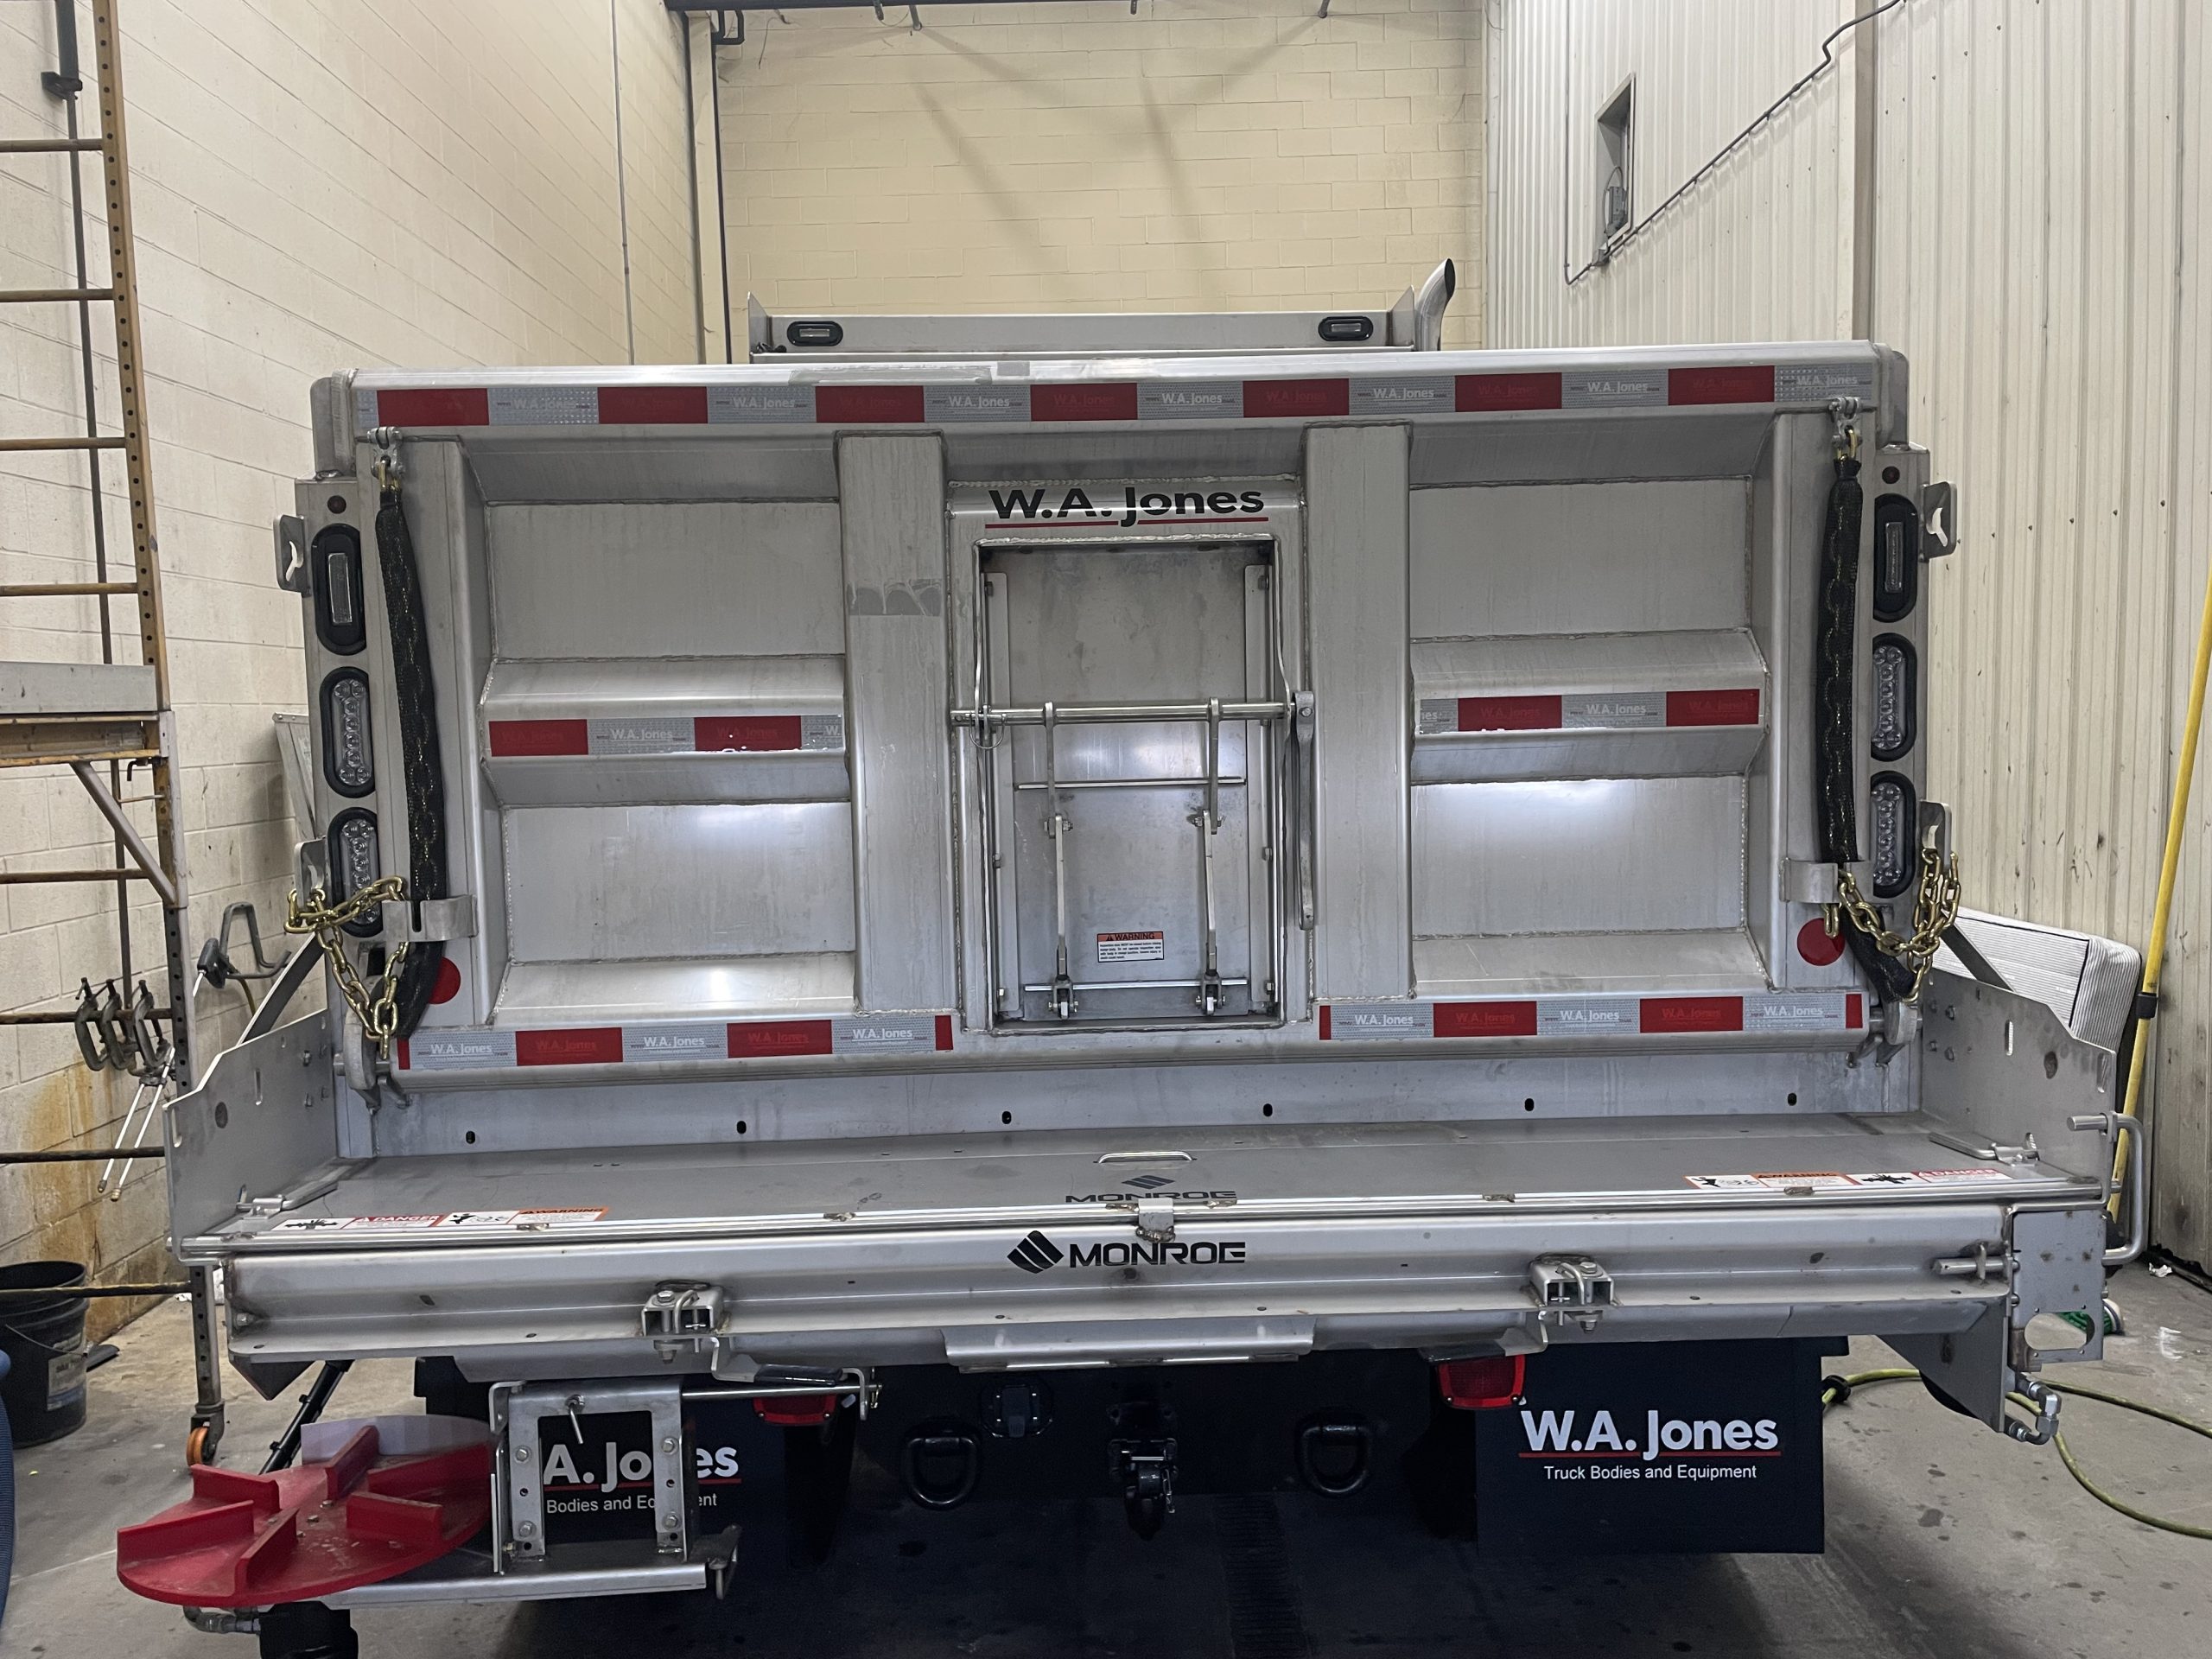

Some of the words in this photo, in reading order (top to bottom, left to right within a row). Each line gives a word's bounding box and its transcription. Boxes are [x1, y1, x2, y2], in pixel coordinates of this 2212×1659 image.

[1587, 382, 1616, 392] W.A.
[1617, 381, 1647, 393] Jones
[1796, 375, 1825, 385] W.A.
[1827, 374, 1858, 387] Jones
[1161, 393, 1190, 404] W.A.
[1192, 392, 1222, 404] Jones
[1373, 388, 1402, 398] W.A.
[1403, 387, 1433, 400] Jones
[732, 397, 762, 408] W.A.
[764, 396, 795, 409] Jones
[948, 395, 977, 406] W.A.
[978, 394, 1009, 408] Jones
[988, 487, 1112, 519] W.A.
[1121, 486, 1264, 527] Jones
[1586, 704, 1613, 715] W.A.
[1616, 703, 1646, 716] Jones
[611, 728, 639, 740] W.A.
[640, 728, 672, 741] Jones
[1115, 932, 1155, 941] WARNING
[1560, 1010, 1587, 1020] W.A.
[1589, 1009, 1619, 1021] Jones
[1764, 1006, 1791, 1016] W.A.
[1793, 1005, 1823, 1017] Jones
[1355, 1014, 1382, 1025] W.A.
[1383, 1014, 1414, 1027] Jones
[852, 1028, 880, 1039] W.A.
[881, 1027, 912, 1039] Jones
[644, 1037, 671, 1047] W.A.
[673, 1036, 704, 1048] Jones
[431, 1044, 459, 1054] W.A.
[461, 1043, 493, 1056] Jones
[1065, 1191, 1237, 1203] MONROE
[1070, 1242, 1246, 1268] MONROE
[1521, 1410, 1637, 1452] W.A.
[1643, 1410, 1779, 1460] Jones
[601, 1441, 739, 1493] Joes
[1544, 1465, 1586, 1480] Truck
[1591, 1465, 1641, 1479] Bodies
[1644, 1465, 1673, 1478] and
[1677, 1464, 1757, 1482] Equipment
[546, 1498, 599, 1514] Bodies
[603, 1496, 632, 1511] and
